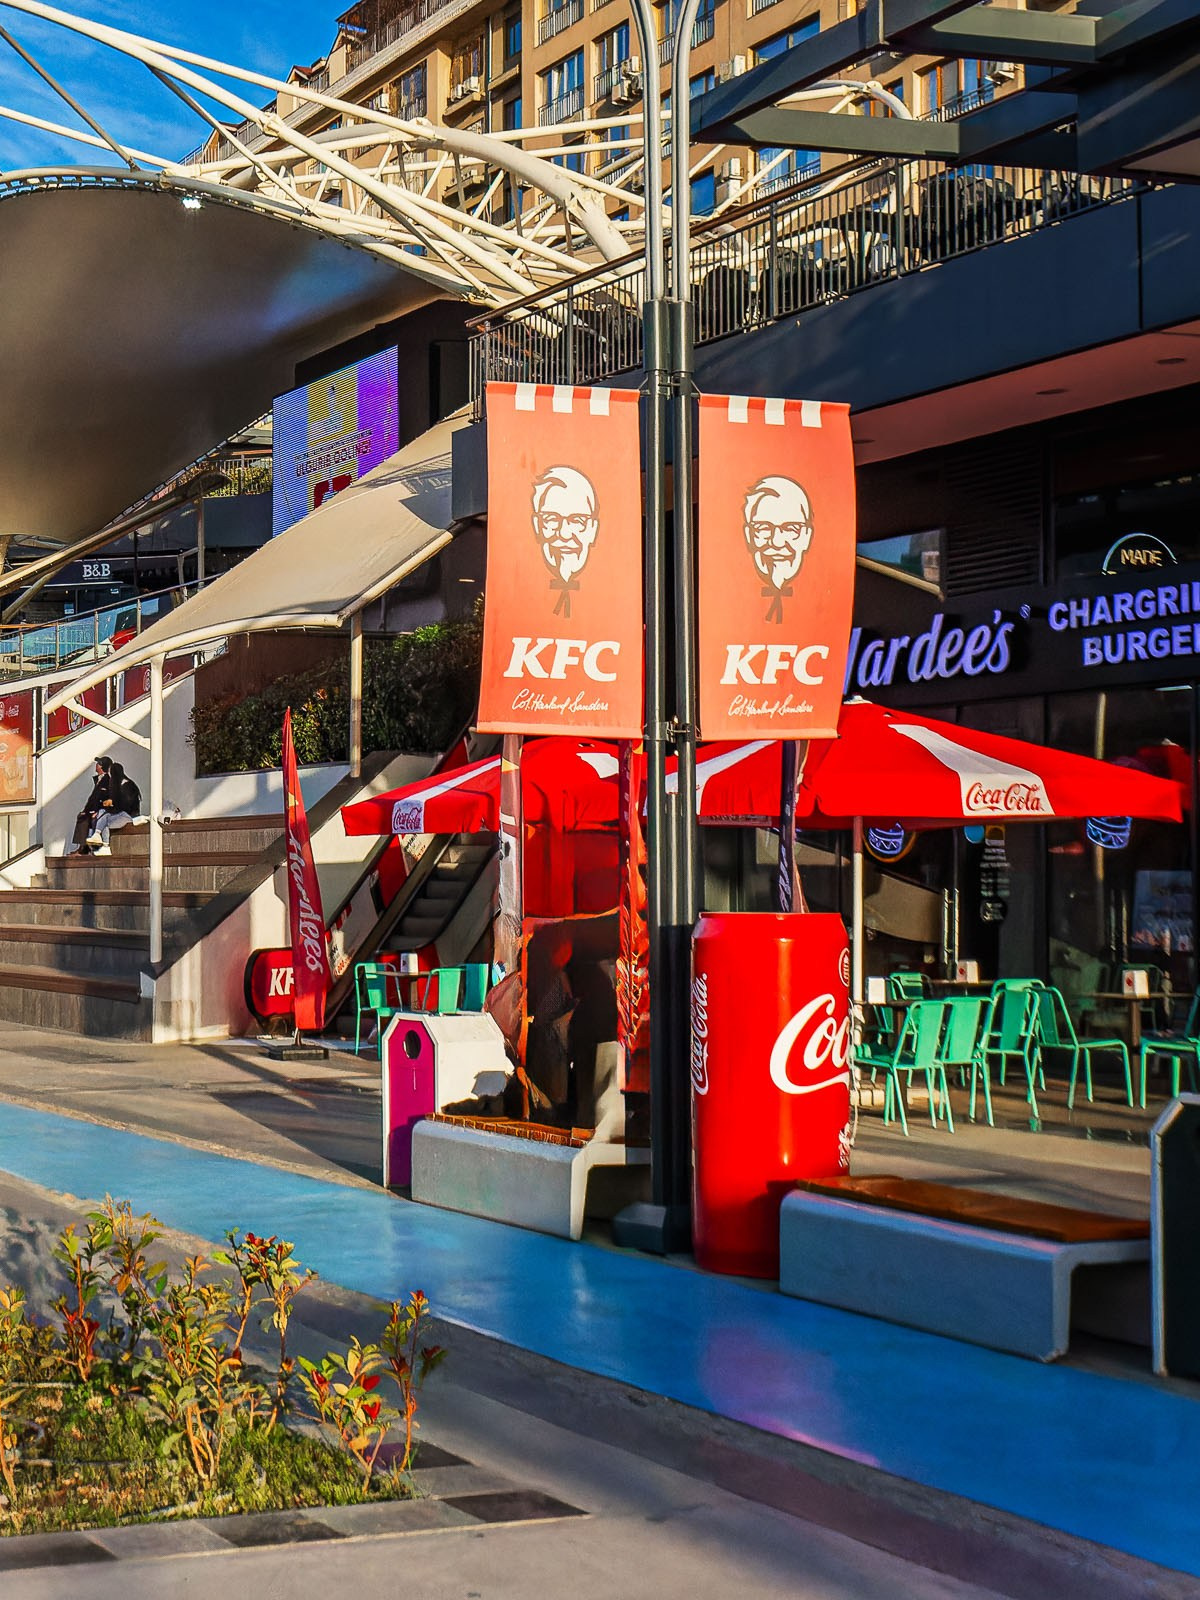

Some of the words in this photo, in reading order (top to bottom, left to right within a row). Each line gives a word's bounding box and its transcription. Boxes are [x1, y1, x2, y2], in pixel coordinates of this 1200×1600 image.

[82, 563, 111, 578] B&B
[1120, 548, 1163, 567] MADE
[503, 637, 621, 682] KFC
[720, 644, 829, 685] KFC
[965, 782, 1044, 812] Coca-Cola
[393, 806, 423, 830] Coca-Cola
[769, 993, 850, 1095] Coc
